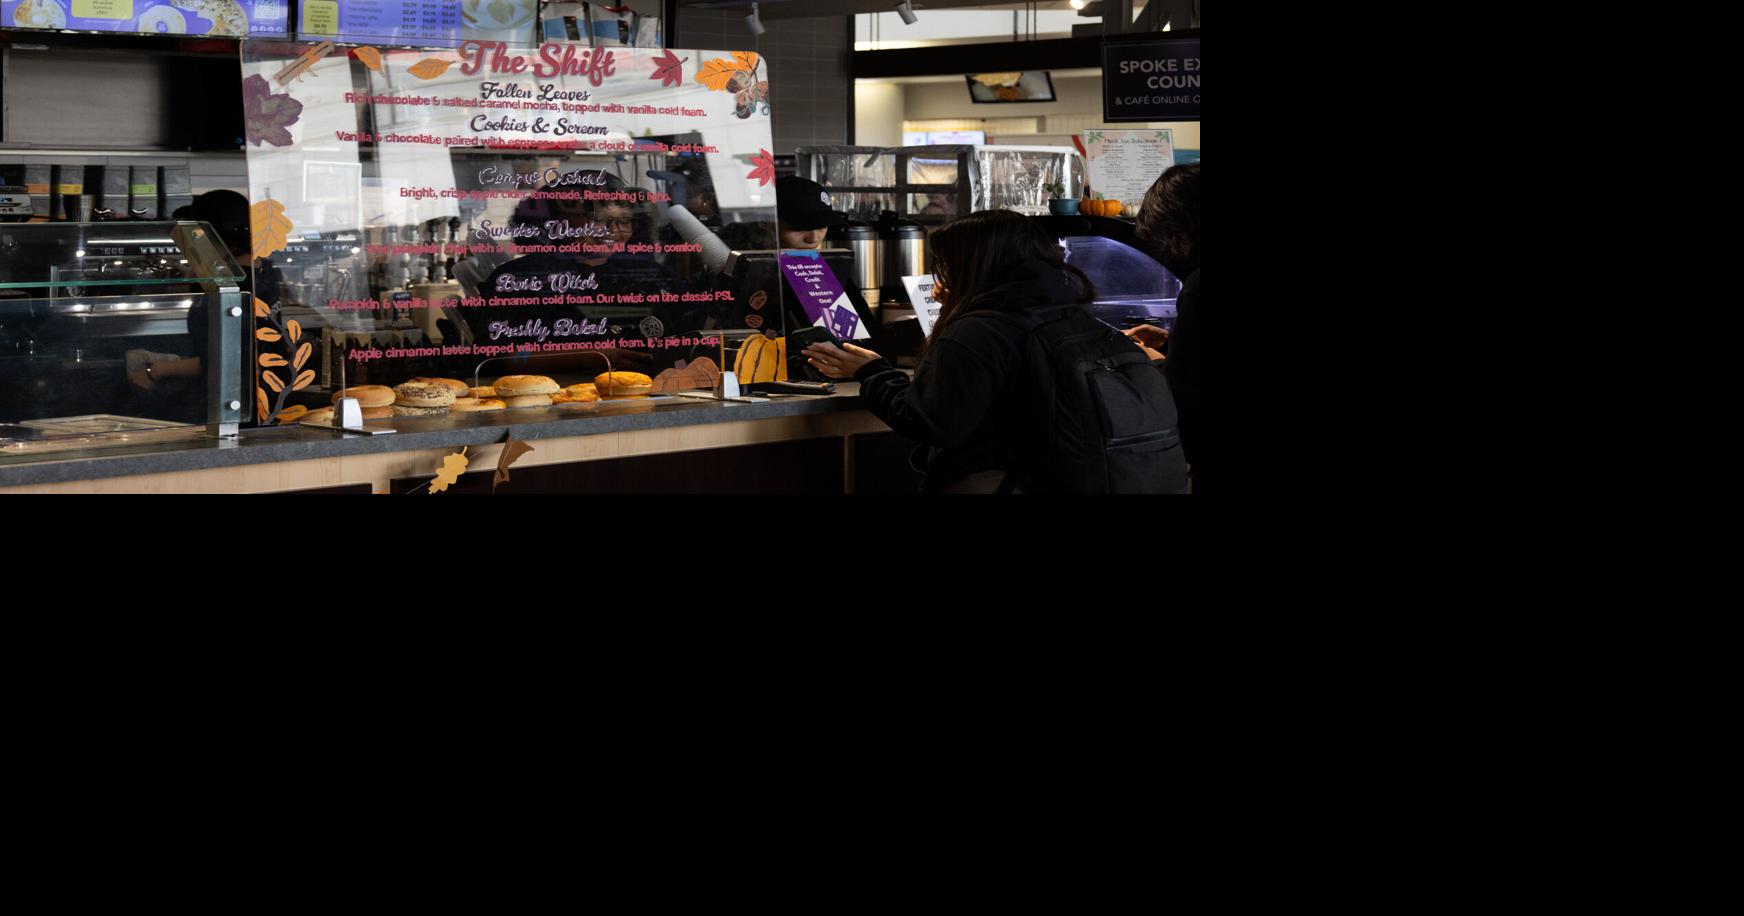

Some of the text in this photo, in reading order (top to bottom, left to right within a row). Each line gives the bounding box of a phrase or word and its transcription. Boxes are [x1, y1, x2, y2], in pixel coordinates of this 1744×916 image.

[459, 40, 616, 87] The Shift
[1119, 58, 1178, 74] SPOKE
[481, 82, 591, 102] Fallen Leaves
[1147, 74, 1200, 89] COUN
[344, 92, 371, 104] Rich
[374, 94, 430, 106] chocolate
[442, 96, 478, 108] salted
[479, 98, 521, 109] caramel
[523, 101, 561, 113] mocha,
[562, 102, 600, 115] topped
[602, 102, 625, 113] with
[627, 104, 657, 115] vanilla
[658, 106, 680, 116] cold
[681, 106, 708, 117] foam.
[1114, 96, 1122, 105] &
[1124, 93, 1150, 105] CAFÉ
[1152, 94, 1190, 105] ONLINE
[470, 114, 609, 136] Cookies & Scream
[336, 131, 373, 142] Vanilla
[385, 132, 442, 144] chocolate
[444, 135, 479, 148] paired
[480, 136, 505, 146] with
[598, 140, 626, 150] cloud
[671, 142, 692, 153] cold
[693, 143, 720, 154] foam.
[479, 165, 607, 190] Campus Orchard
[400, 186, 438, 201] Bright,
[440, 187, 467, 201] crisp
[530, 189, 582, 200] lemonade.
[584, 189, 637, 203] Refreshing
[476, 219, 611, 239] Sweater Weather
[470, 241, 495, 253] with
[506, 241, 557, 253] cinnamon
[558, 242, 581, 253] cold
[612, 242, 625, 252] All
[627, 242, 654, 254] spice
[495, 271, 599, 293] Basic Witch
[328, 298, 380, 312] Pumpkin
[393, 297, 428, 309] vanilla
[460, 296, 486, 307] with
[488, 295, 540, 306] cinnamon
[542, 294, 564, 304] cold
[566, 293, 595, 304] foam.
[597, 293, 615, 304] Our
[617, 292, 645, 304] twist
[646, 293, 660, 303] on
[661, 291, 680, 302] the
[681, 290, 713, 302] classic
[488, 317, 608, 342] Freshly Baked
[348, 335, 720, 362] Apple cinnamon latte topped with cinnamon cold foam. It's pie in a cup.
